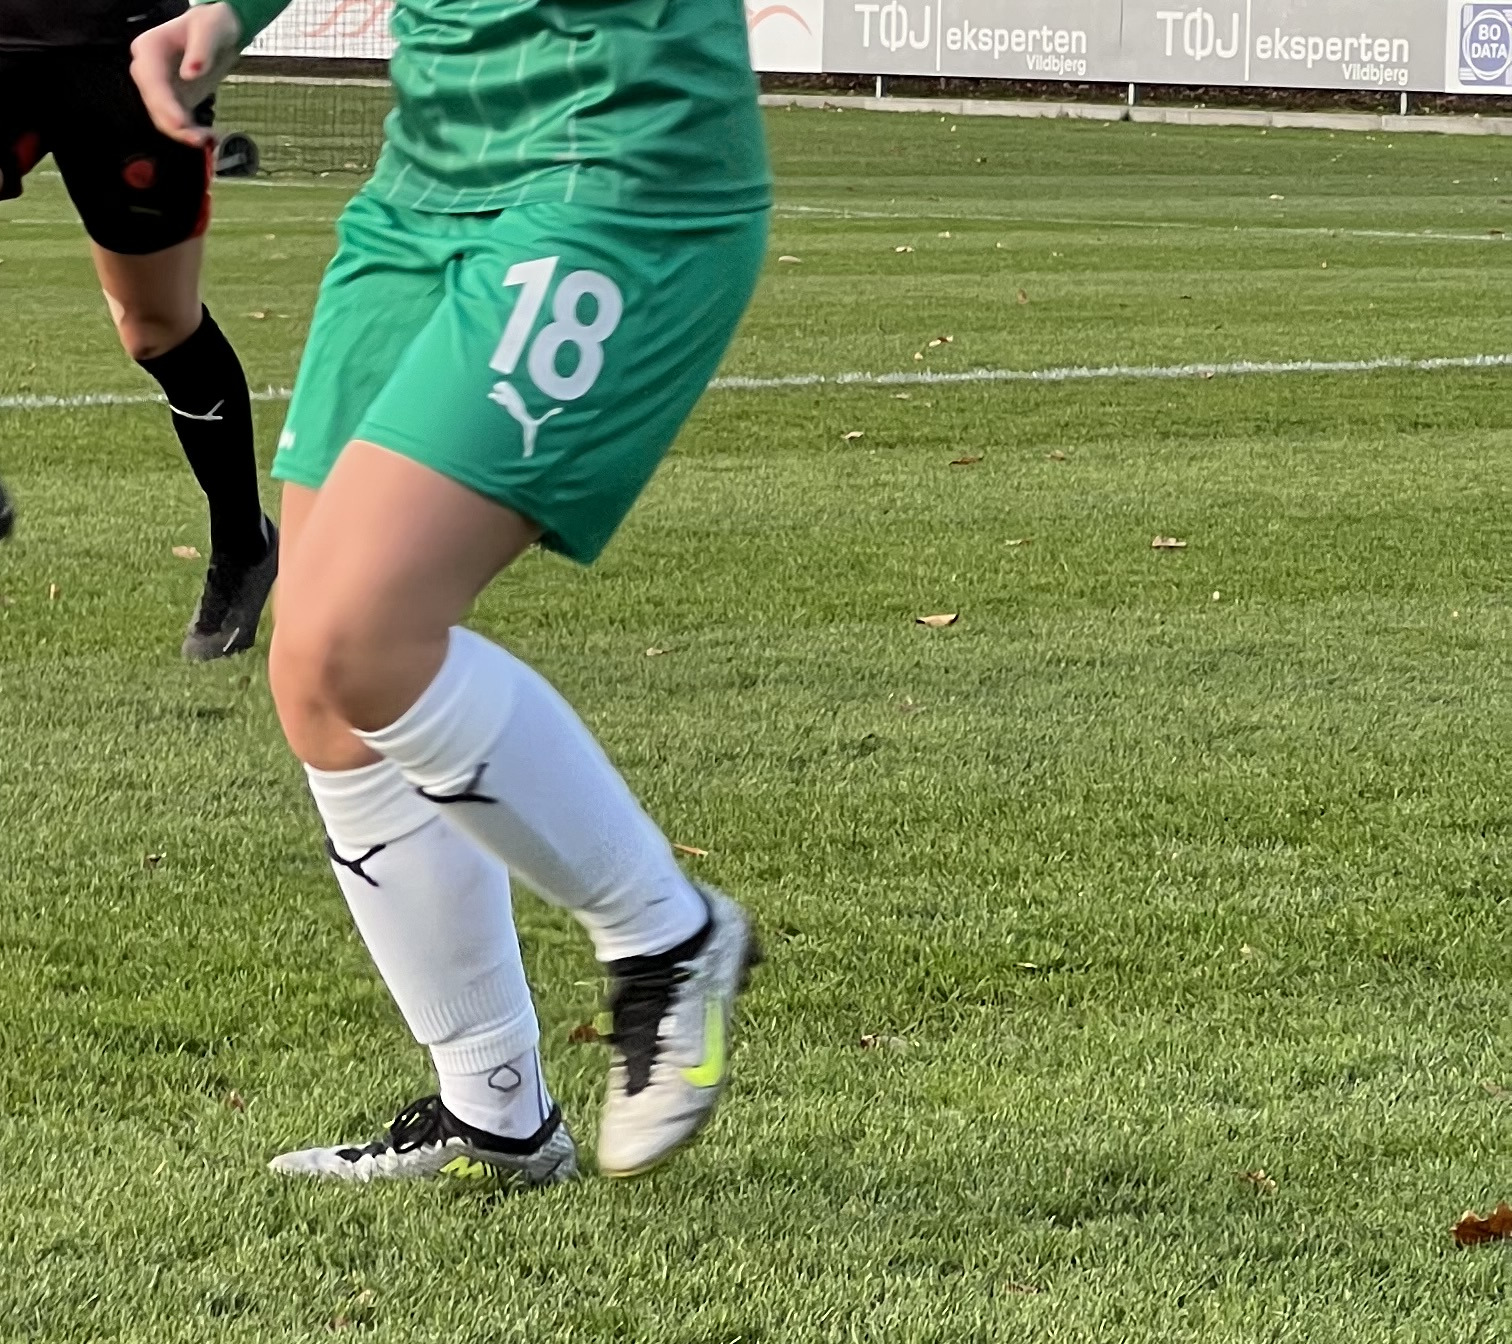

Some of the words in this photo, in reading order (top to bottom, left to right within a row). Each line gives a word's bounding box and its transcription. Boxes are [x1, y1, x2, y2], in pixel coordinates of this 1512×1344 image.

[854, 0, 931, 52] TØJ
[946, 19, 1088, 60] eksperten
[1156, 7, 1240, 61] TØJ
[1255, 27, 1410, 68] eksperten
[1478, 23, 1502, 42] BO
[1471, 41, 1508, 60] DATA
[1026, 54, 1087, 76] Vildbjerg
[1342, 63, 1409, 85] Vildbjerg
[489, 255, 624, 401] 18
